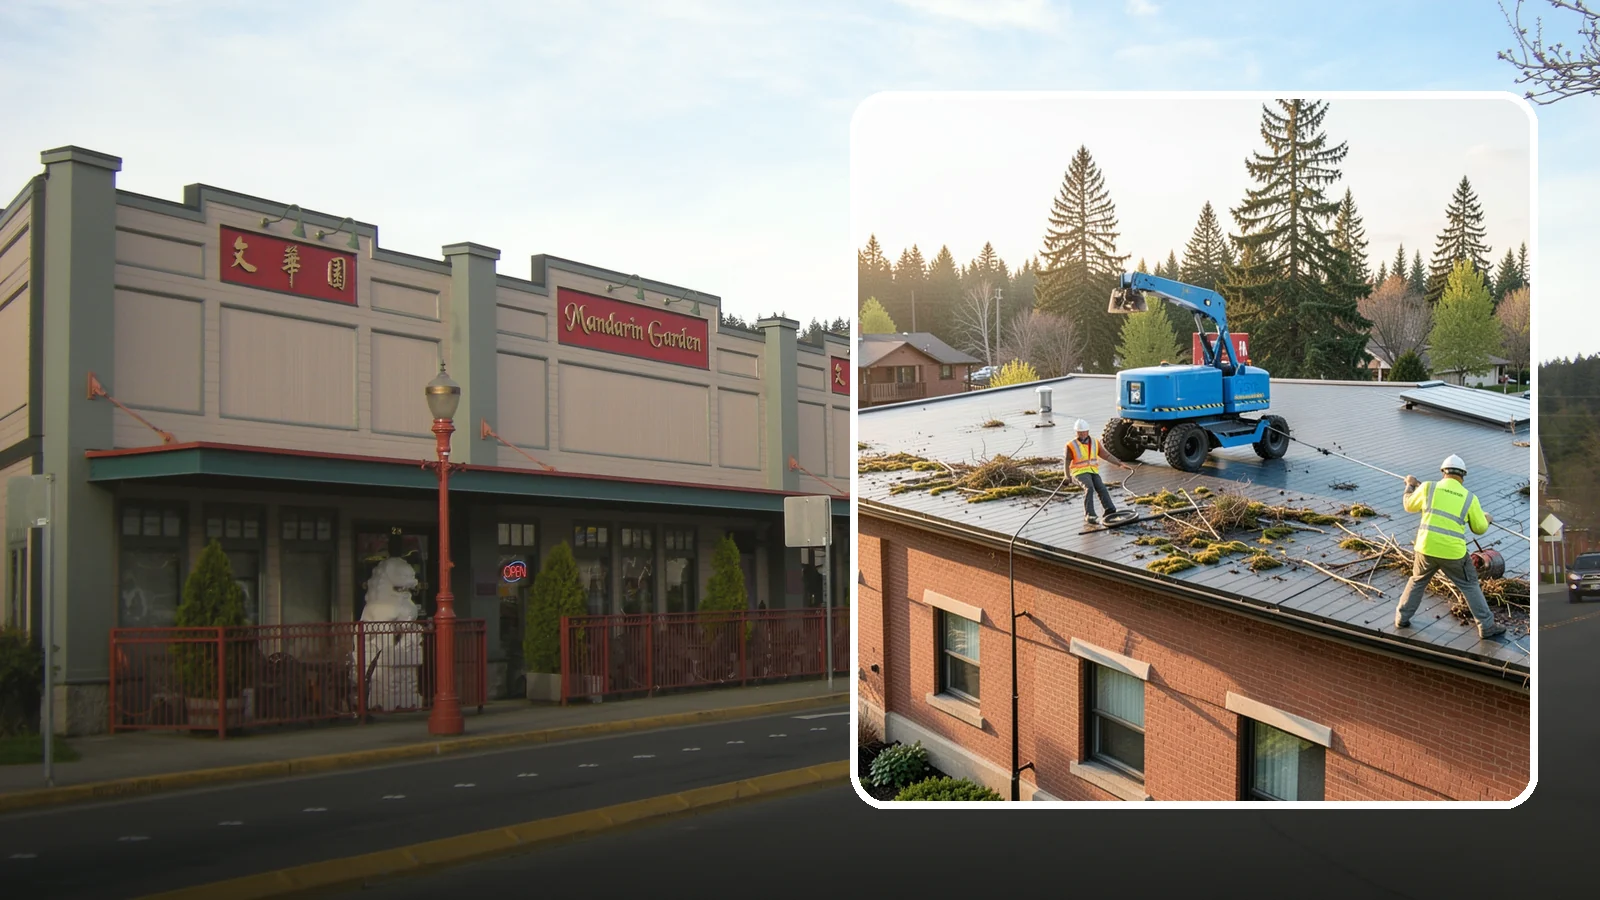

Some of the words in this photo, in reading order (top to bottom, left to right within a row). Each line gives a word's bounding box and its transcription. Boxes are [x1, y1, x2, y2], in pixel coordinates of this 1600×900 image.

[230, 235, 346, 291] 文華園
[564, 302, 644, 341] Mandarin
[648, 320, 702, 352] Garden
[834, 362, 846, 386] 文
[503, 565, 527, 578] OPEN
